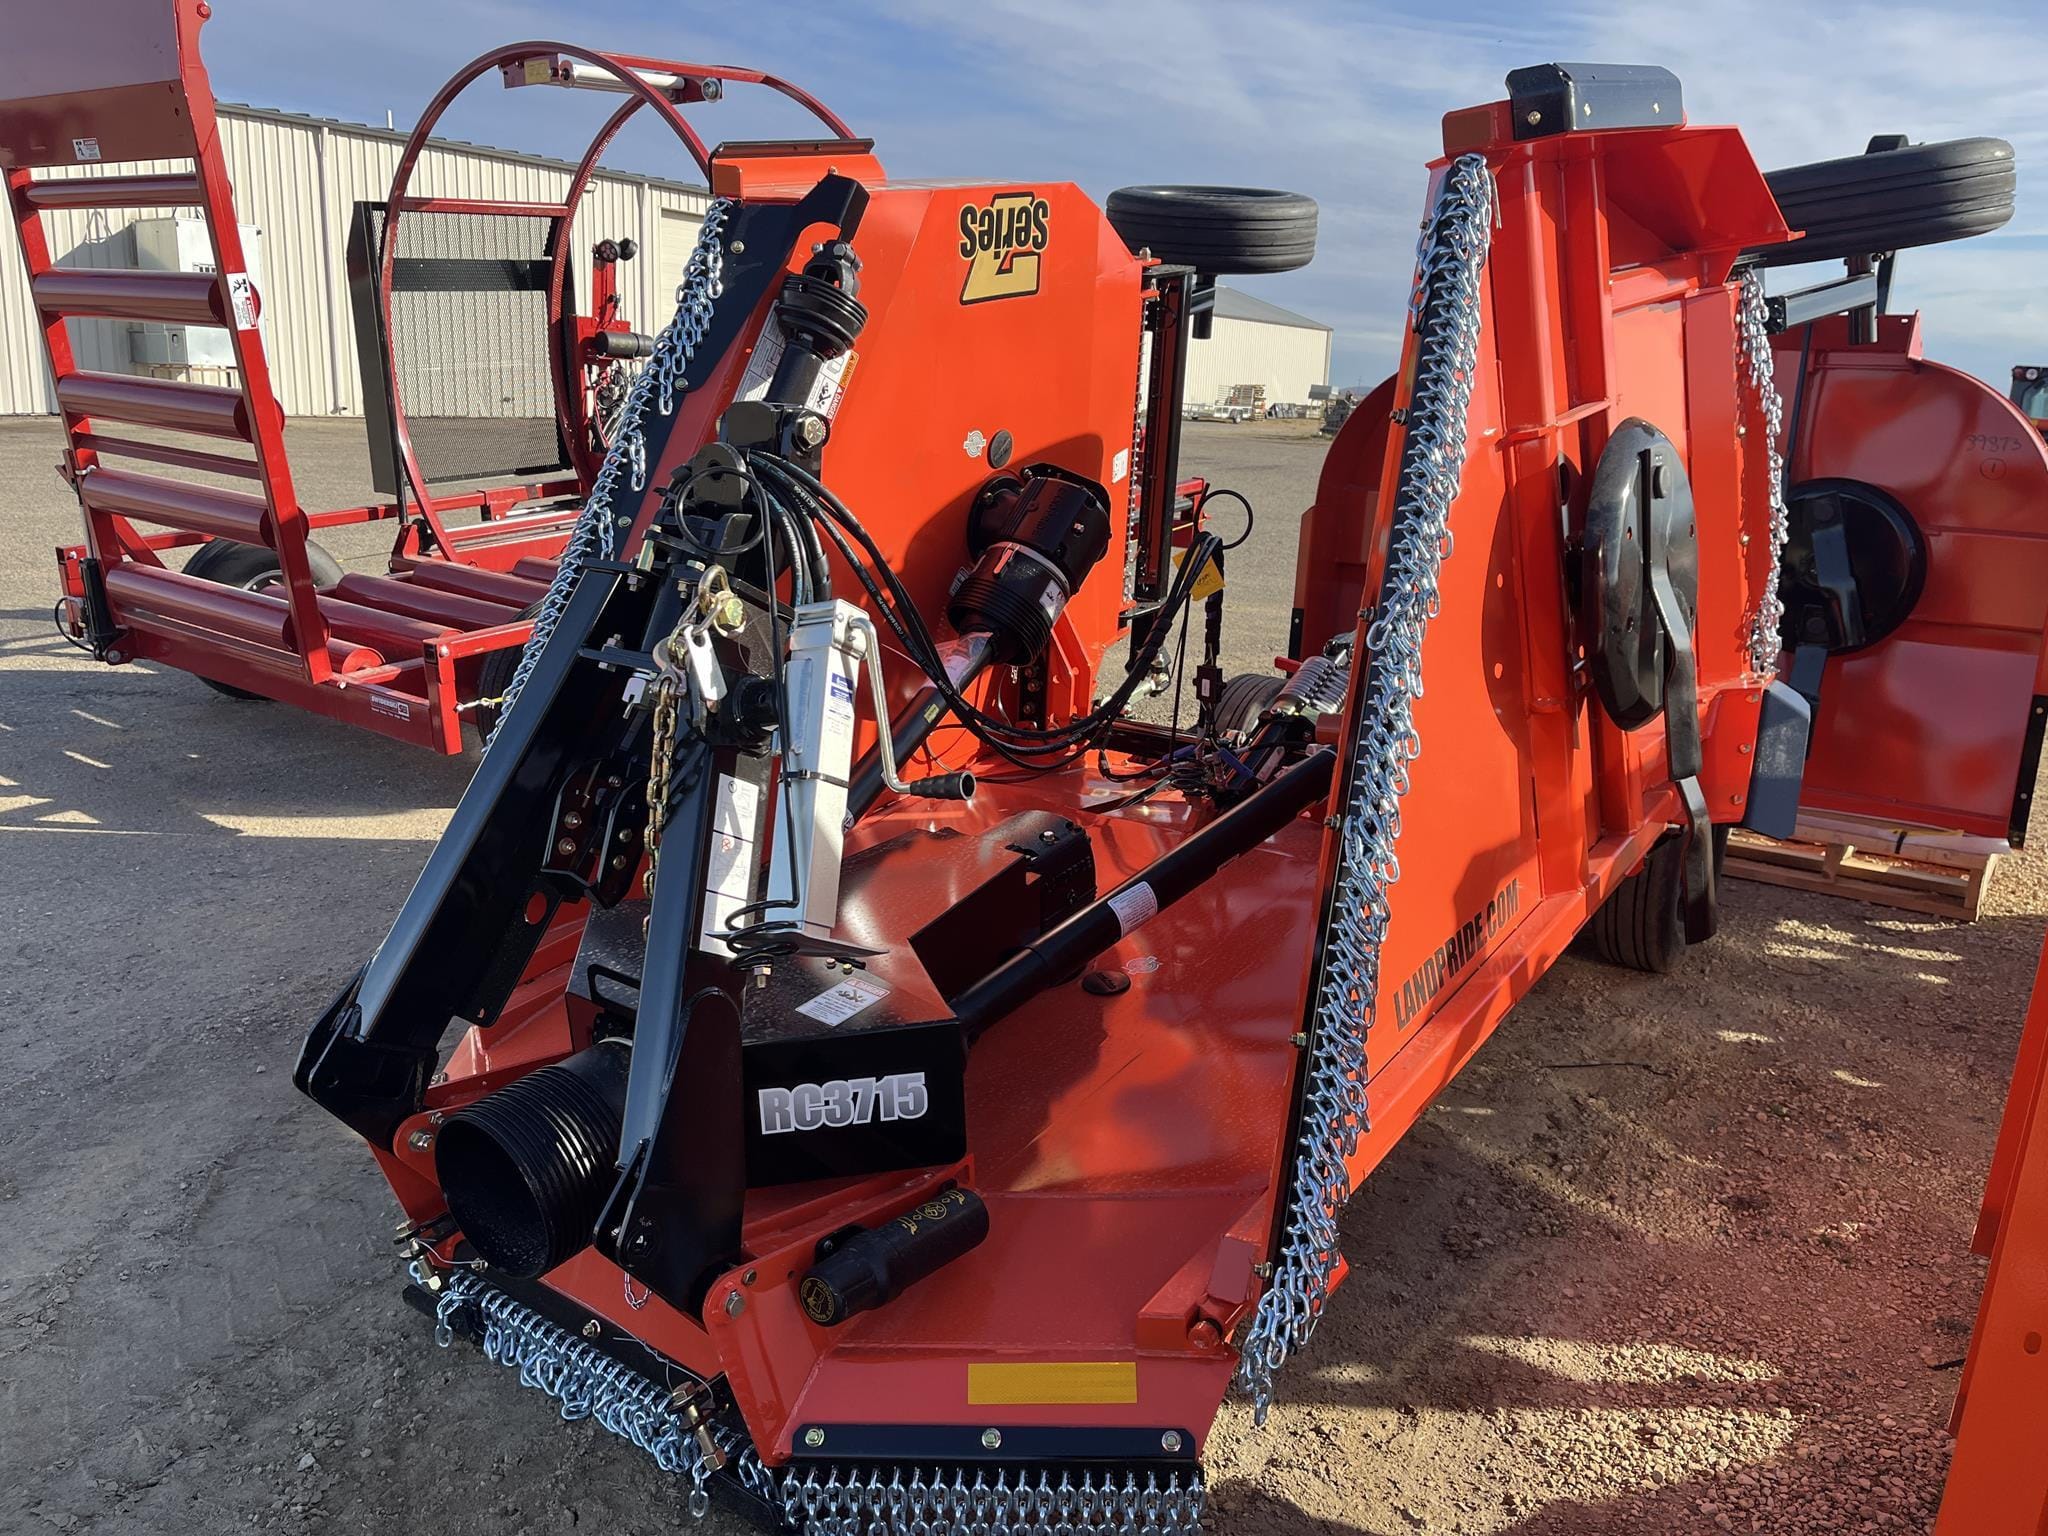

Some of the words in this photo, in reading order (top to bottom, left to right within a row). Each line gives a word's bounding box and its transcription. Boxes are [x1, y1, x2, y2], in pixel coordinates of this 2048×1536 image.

[826, 393, 842, 420] DANGER
[1393, 877, 1519, 1033] LANDPRIDE.COM
[758, 1071, 929, 1135] RC3715
